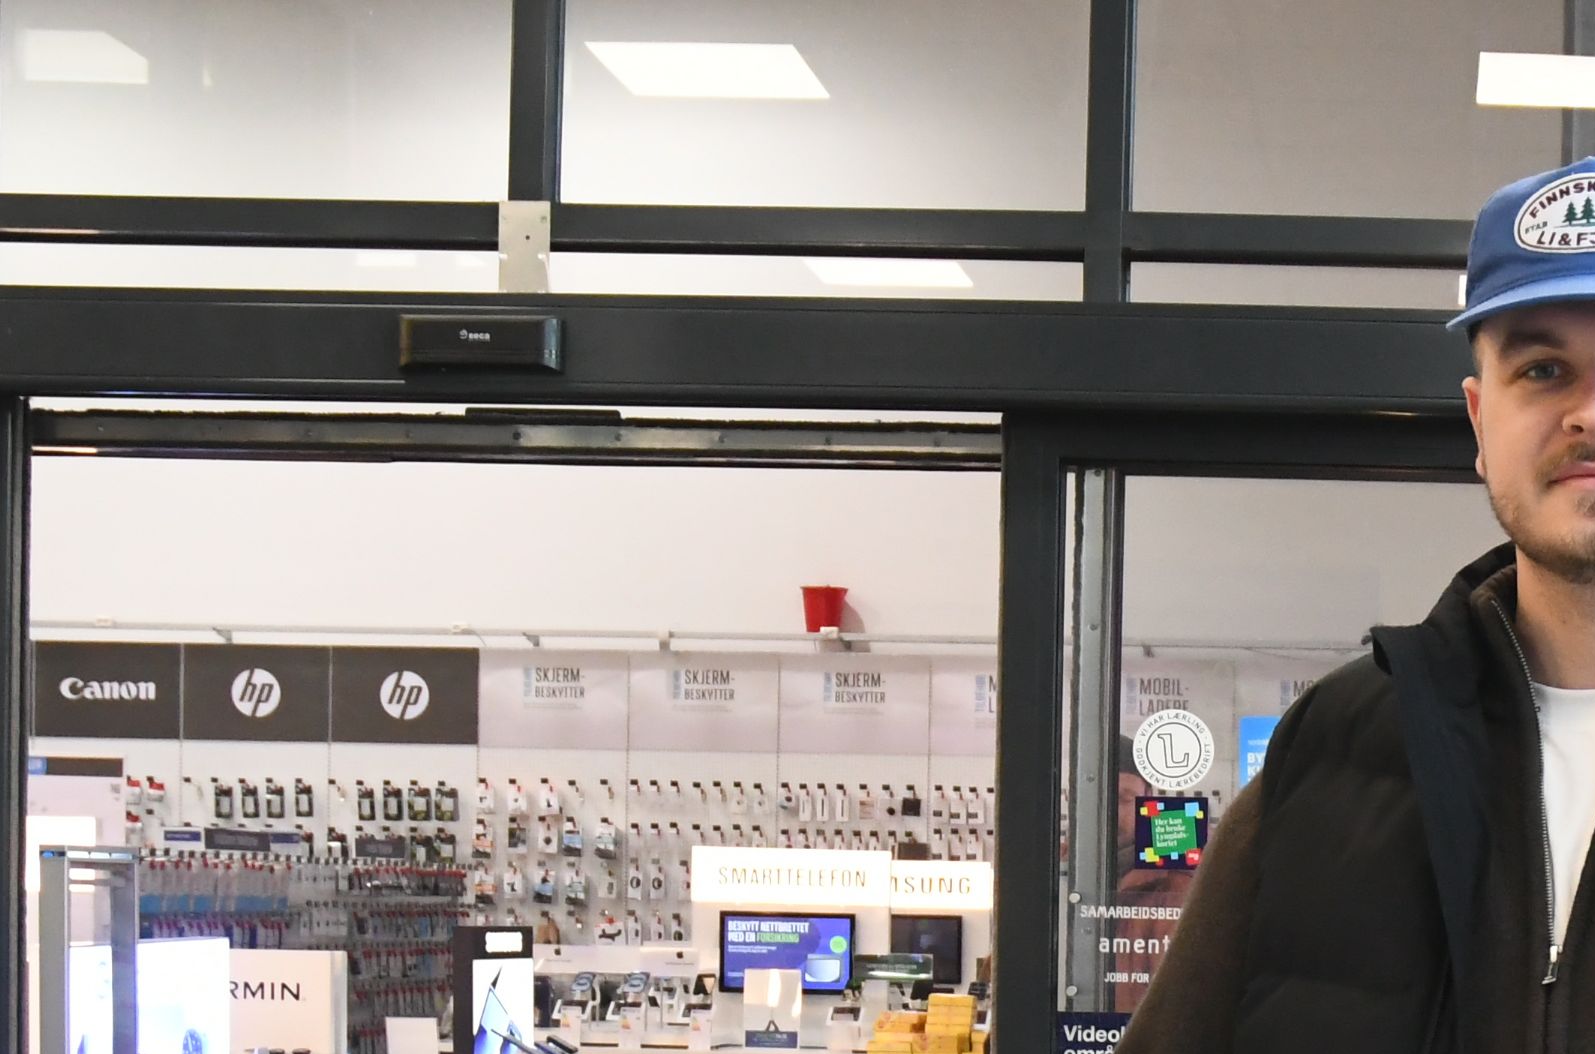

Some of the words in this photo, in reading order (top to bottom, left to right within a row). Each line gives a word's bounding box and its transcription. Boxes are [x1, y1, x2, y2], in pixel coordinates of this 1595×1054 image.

[535, 667, 586, 683] SKJERM-
[684, 669, 735, 685] SKJERM-
[835, 672, 886, 688] SKJERM-
[59, 677, 156, 701] Canon
[239, 668, 274, 717] hp
[387, 670, 423, 720] hp
[535, 686, 585, 698] BESKYTTER
[684, 688, 735, 700] BESKYTTER
[1140, 678, 1189, 696] MOBIL-
[834, 691, 885, 703] BESKYTTER
[1147, 715, 1164, 728] HAR
[1167, 713, 1206, 734] LÆRLING
[1136, 747, 1165, 785] GODKJENT
[718, 867, 867, 888] SMARTTELEFON
[1080, 905, 1184, 920] SAMARBEIDSBED
[1104, 972, 1129, 983] JOBB
[1131, 972, 1149, 983] FOR
